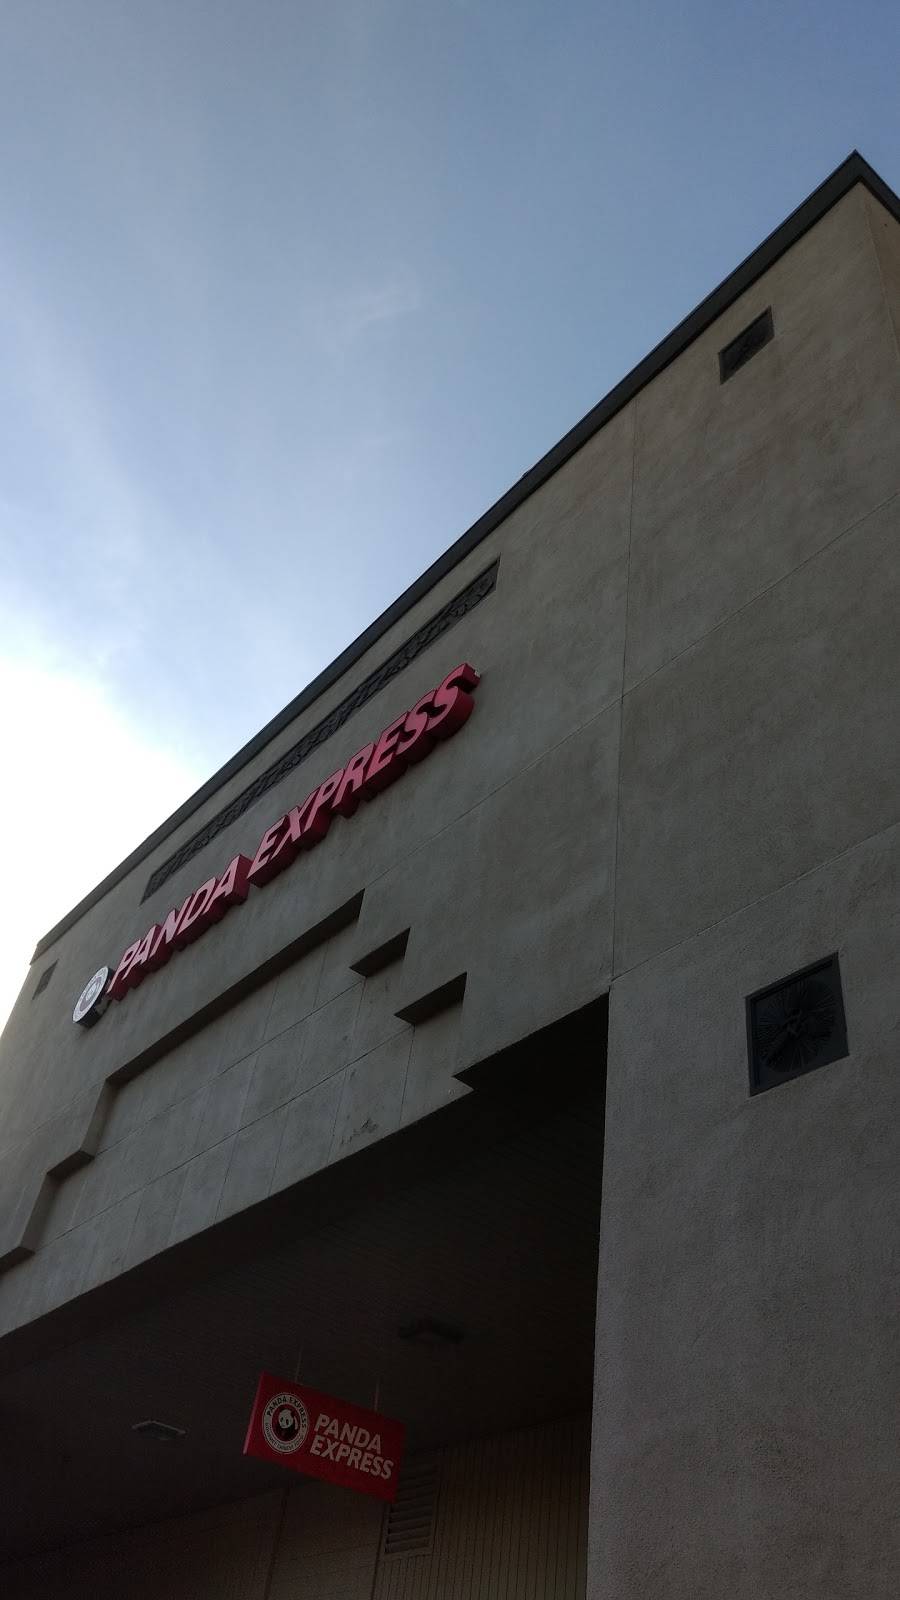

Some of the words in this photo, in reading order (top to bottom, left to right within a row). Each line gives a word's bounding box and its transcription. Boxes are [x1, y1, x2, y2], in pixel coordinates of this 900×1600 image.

[106, 854, 247, 996] PANDA
[247, 663, 475, 882] EXPRESS
[266, 1396, 287, 1417] PANDA
[314, 1413, 382, 1455] PANDA
[310, 1434, 395, 1480] EXPRESS
